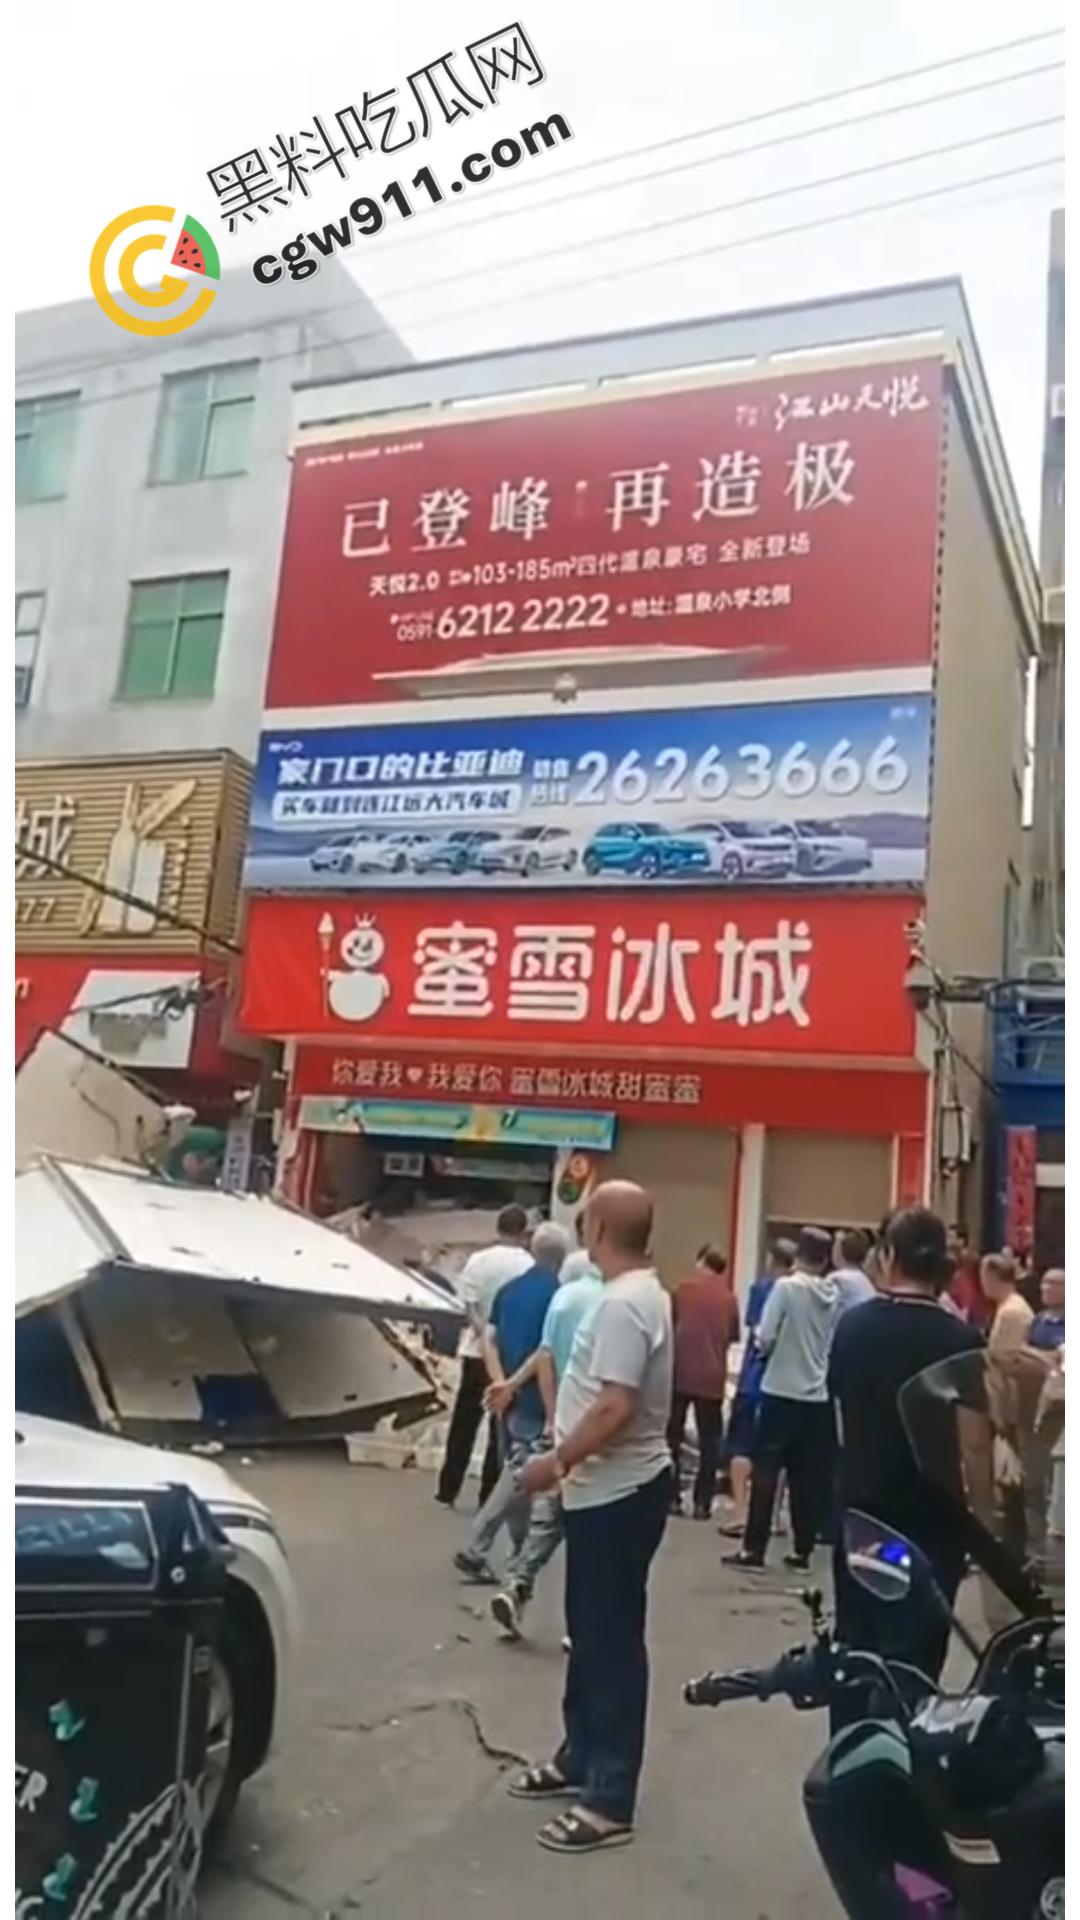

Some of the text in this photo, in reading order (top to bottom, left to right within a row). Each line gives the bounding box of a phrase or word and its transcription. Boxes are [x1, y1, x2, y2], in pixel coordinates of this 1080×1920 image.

[342, 440, 856, 557] 已登峰 再造极
[718, 530, 811, 564] 全新登场
[437, 600, 516, 640] 6212
[520, 592, 610, 633] 2222
[576, 734, 909, 804] 26263666
[407, 918, 813, 1027] 蜜雪冰城
